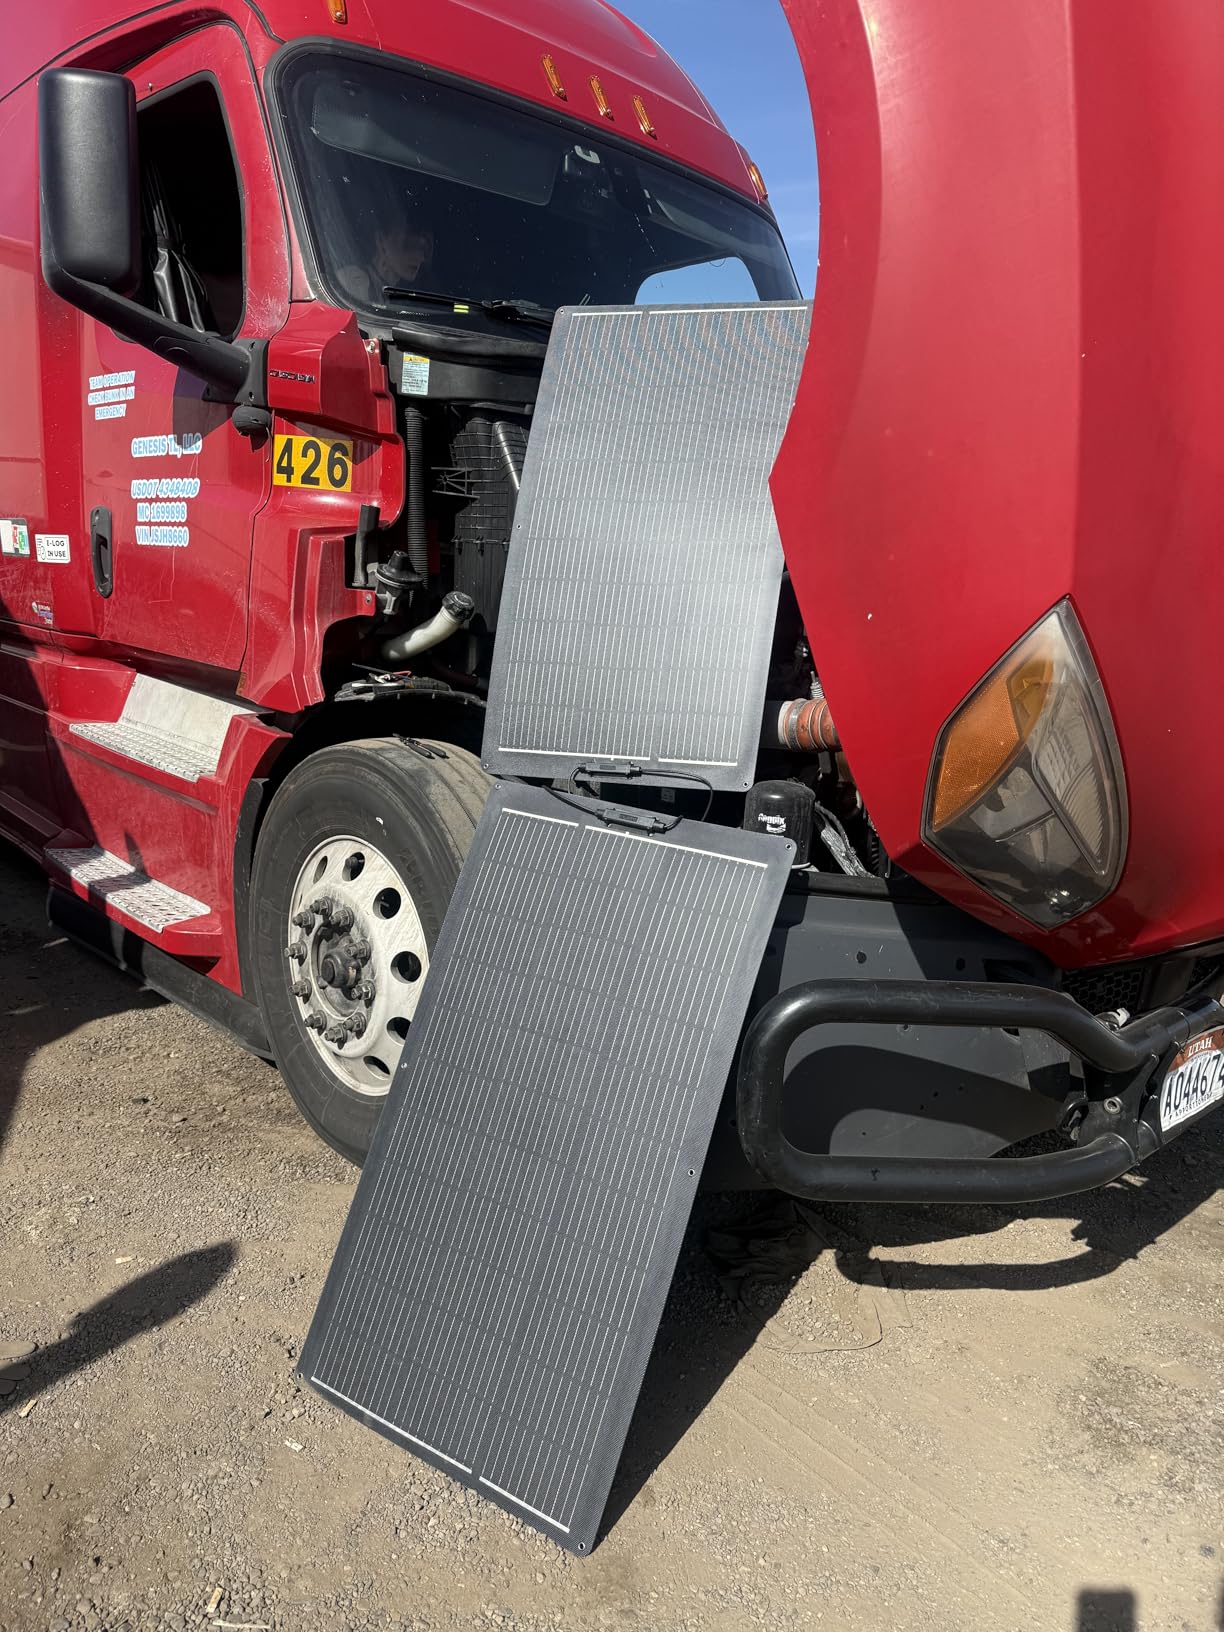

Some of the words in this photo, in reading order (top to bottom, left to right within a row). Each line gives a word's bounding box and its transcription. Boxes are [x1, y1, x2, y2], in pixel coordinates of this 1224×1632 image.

[103, 372, 134, 387] OPERATION
[96, 404, 126, 419] EMERGENCY
[132, 437, 167, 456] GENESIS
[183, 434, 202, 453] LLC
[276, 437, 349, 489] 426
[131, 481, 158, 497] USDOT
[158, 480, 199, 496] 4348408
[138, 504, 150, 520] MC
[151, 504, 186, 520] 1699898
[136, 527, 150, 543] VIN
[54, 550, 66, 558] USE
[1187, 1036, 1214, 1058] UTAH
